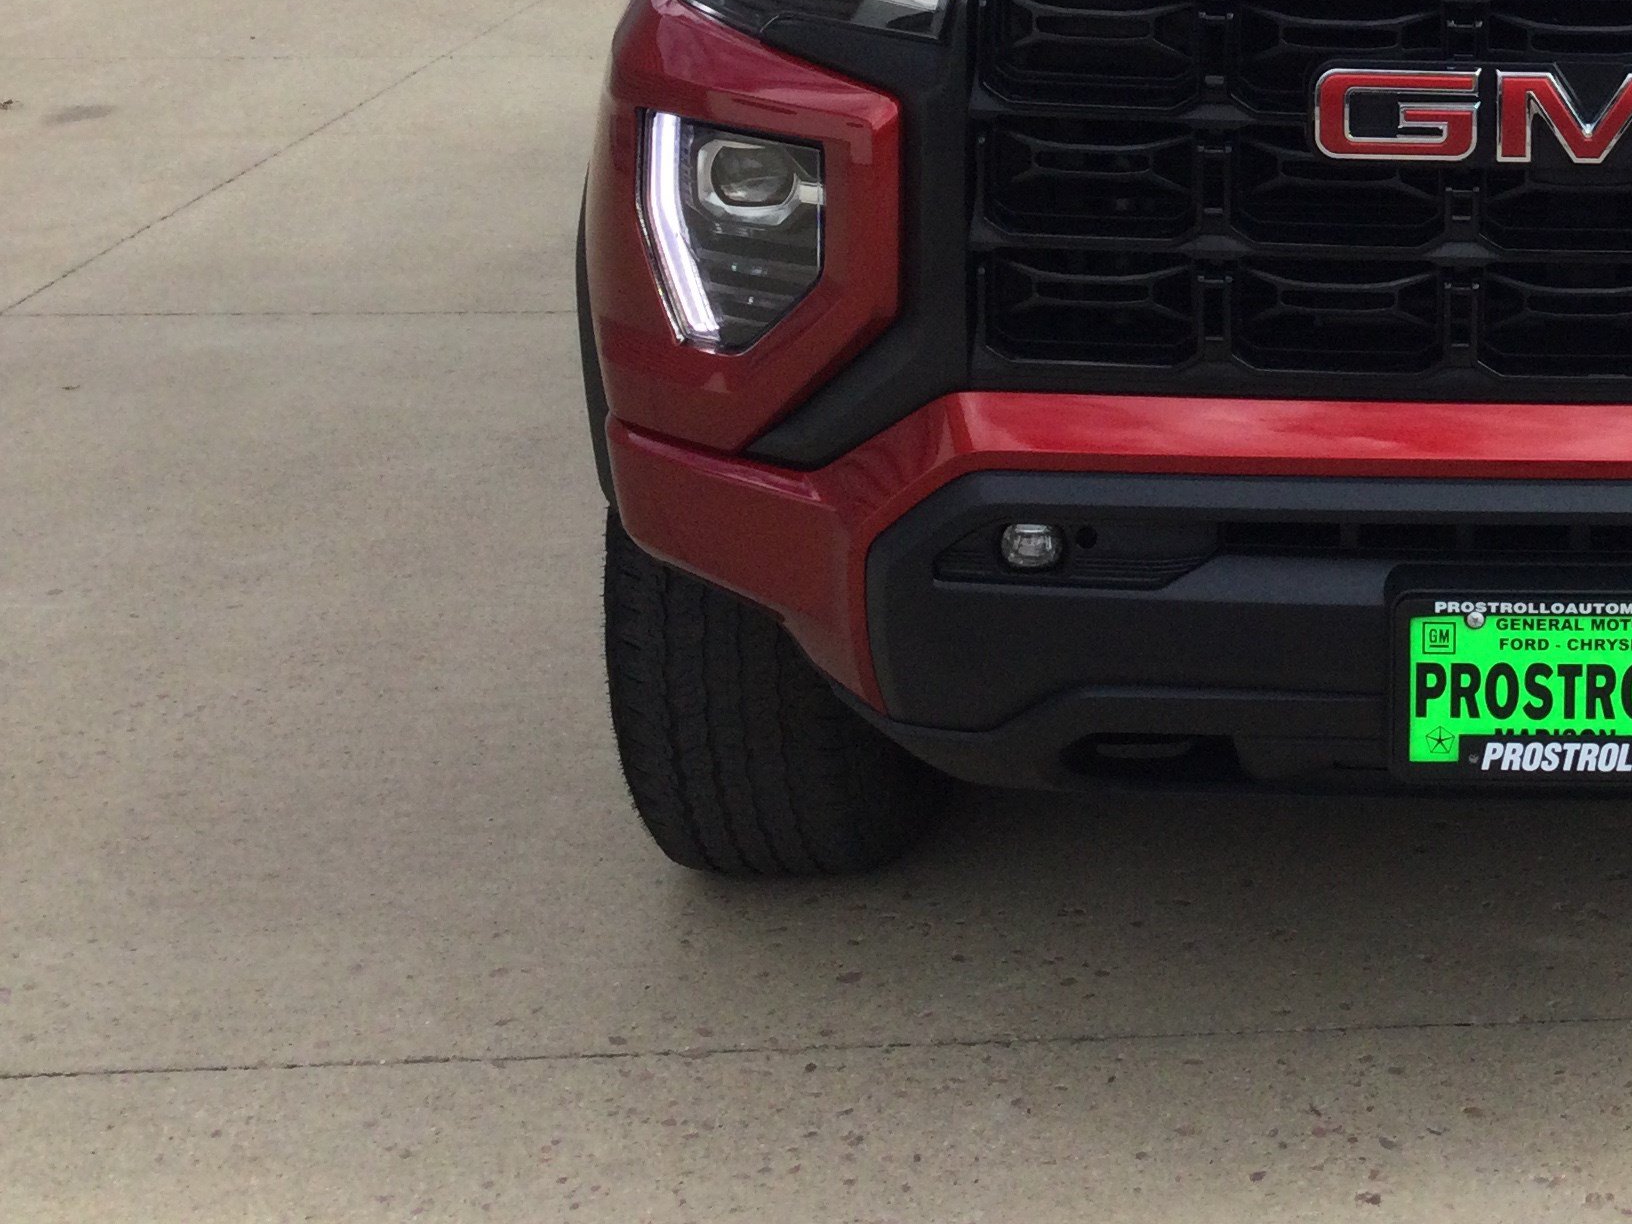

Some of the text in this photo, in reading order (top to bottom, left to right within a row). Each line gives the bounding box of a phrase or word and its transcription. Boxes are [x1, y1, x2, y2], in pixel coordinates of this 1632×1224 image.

[1495, 617, 1585, 632] GENERAL
[1428, 628, 1450, 644] GM
[1499, 638, 1550, 651] FORD
